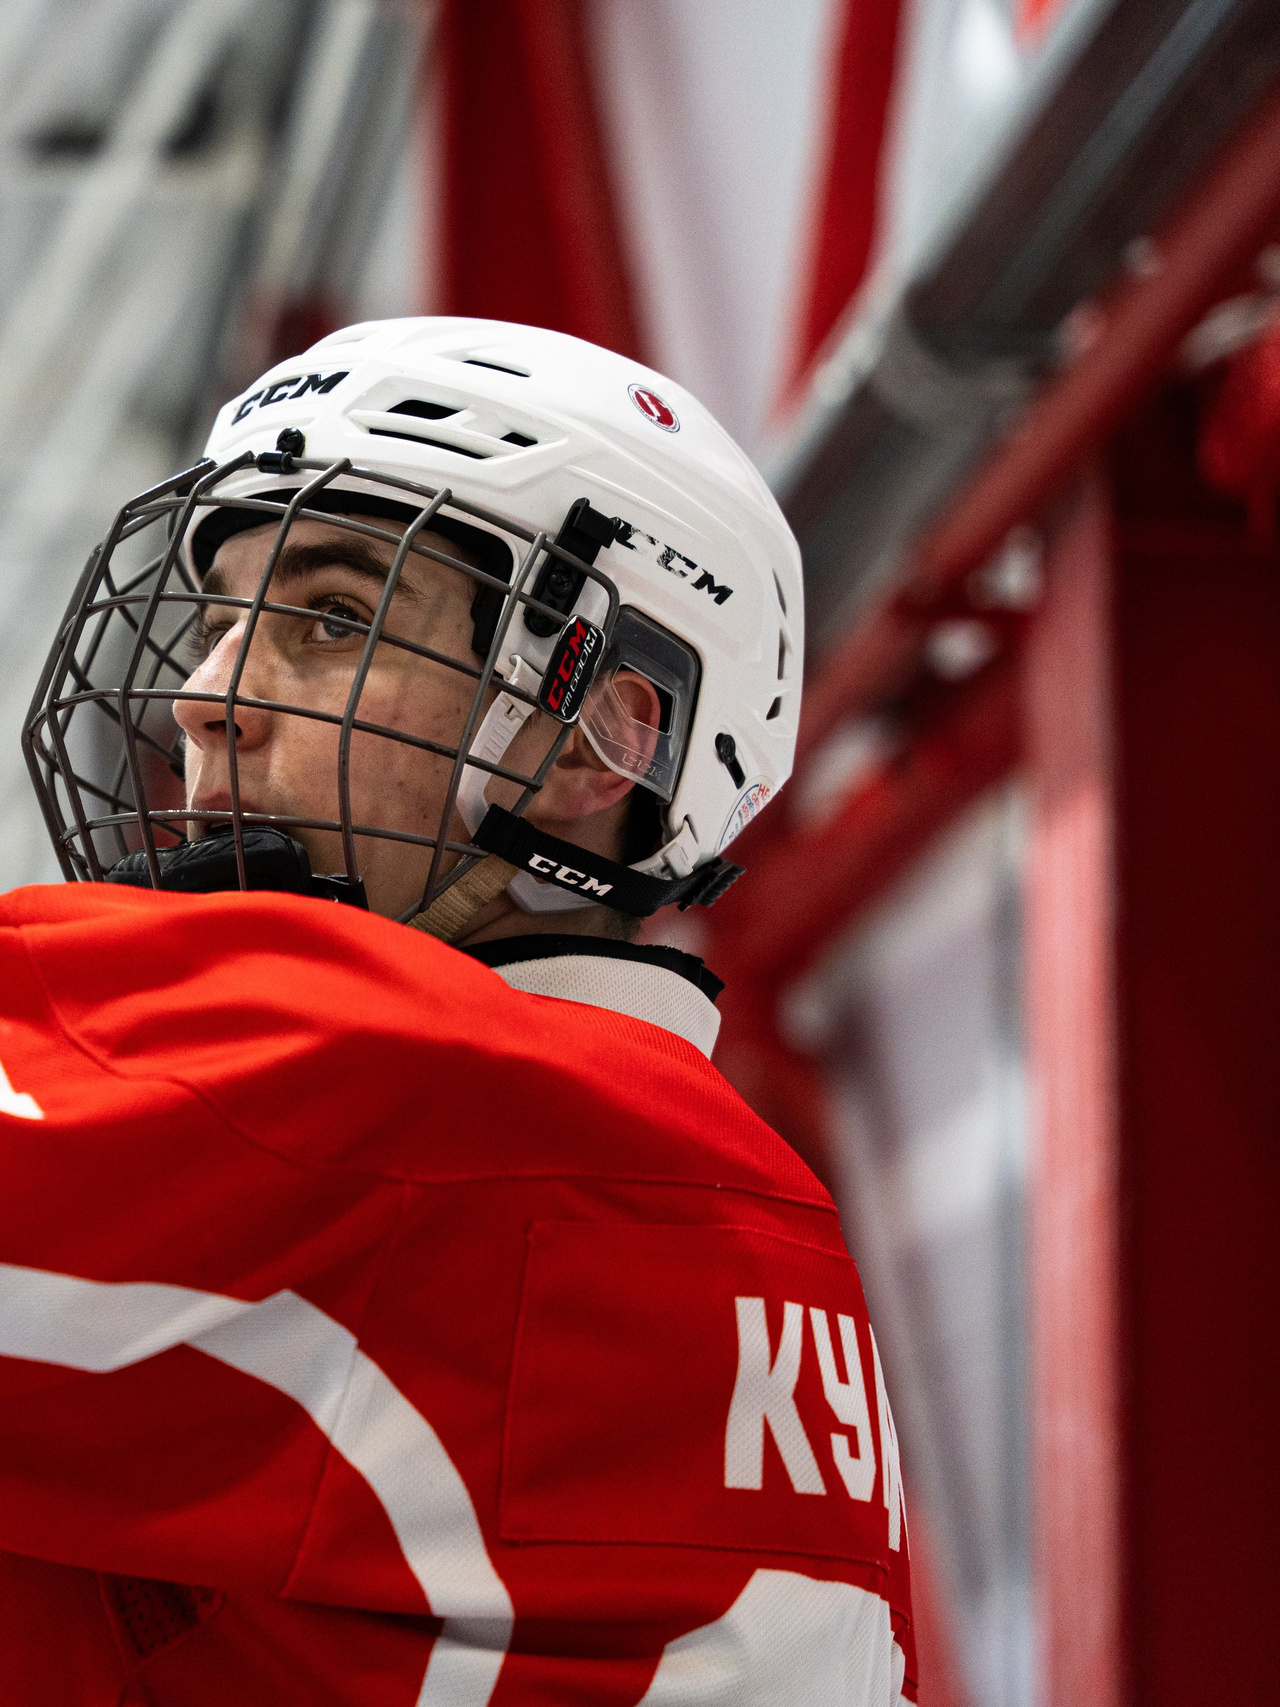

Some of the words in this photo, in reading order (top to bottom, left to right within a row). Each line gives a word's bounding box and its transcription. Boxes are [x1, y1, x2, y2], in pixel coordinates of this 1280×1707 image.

[231, 371, 350, 426] CCM
[615, 520, 734, 606] CCM
[547, 620, 587, 711] CCM
[528, 852, 614, 897] CCM
